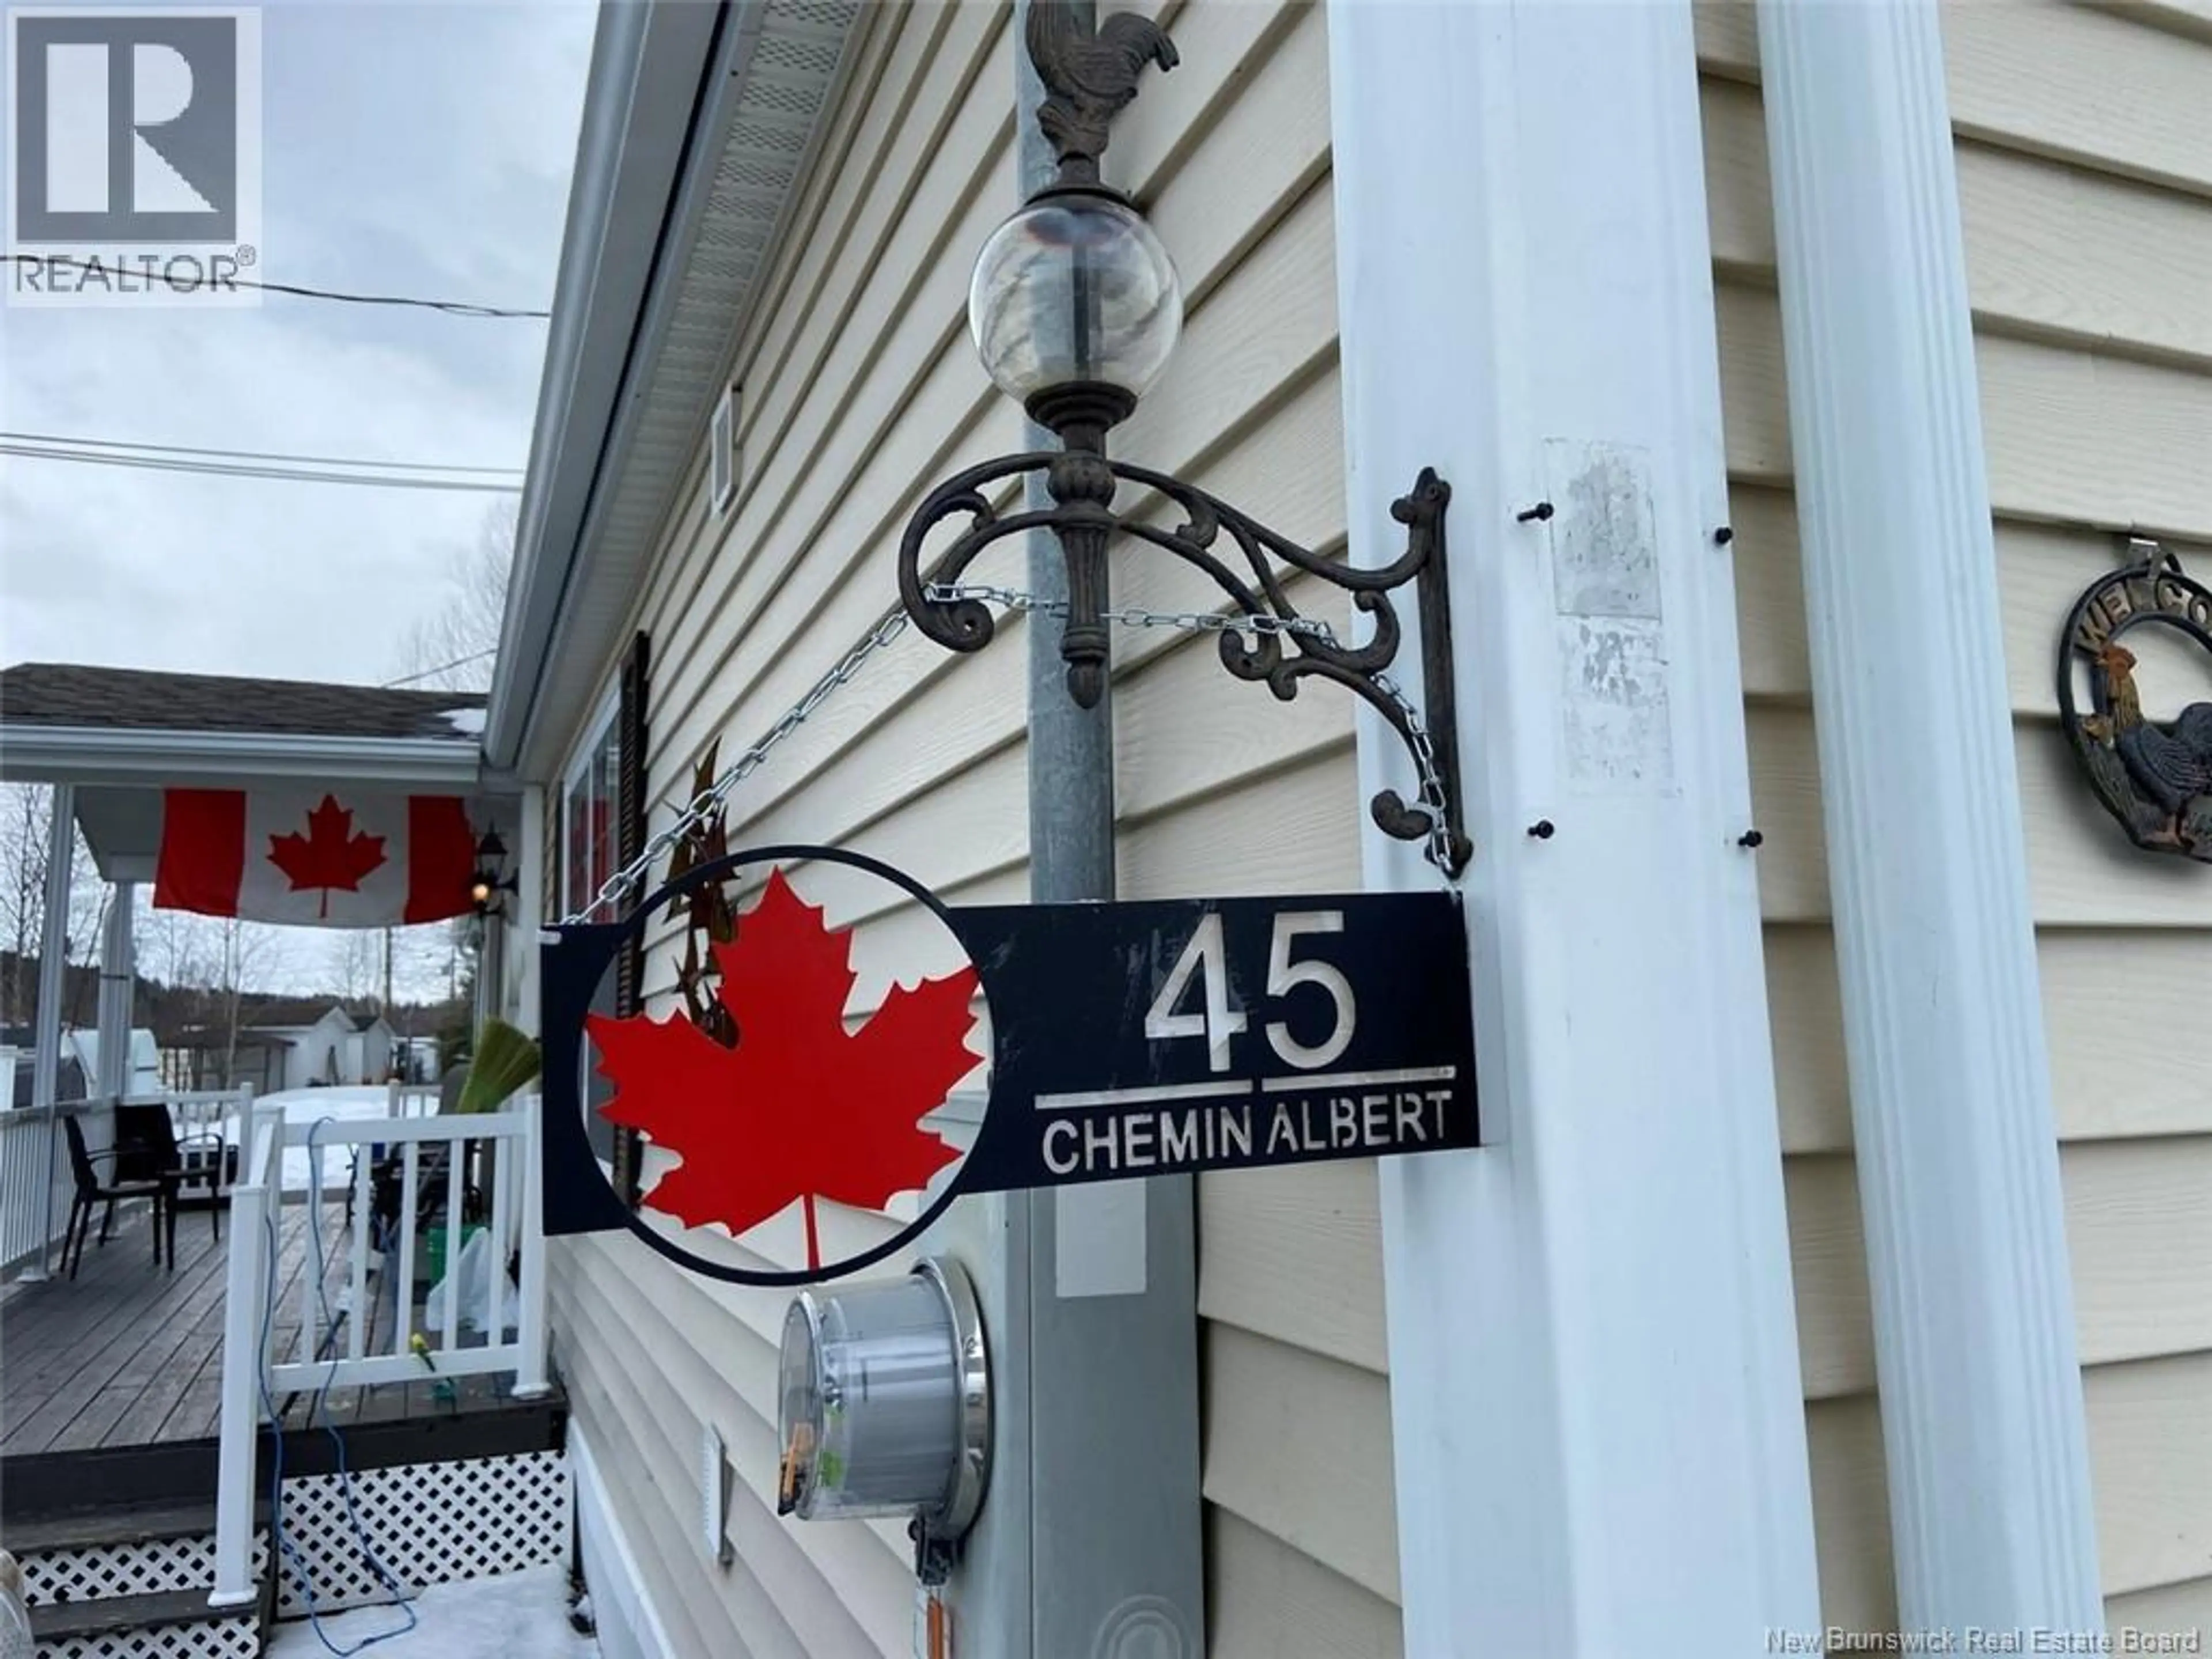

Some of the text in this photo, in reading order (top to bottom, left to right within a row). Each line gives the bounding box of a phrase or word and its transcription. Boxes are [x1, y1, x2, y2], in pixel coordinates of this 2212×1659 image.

[1145, 911, 1356, 1071] 45
[1042, 1090, 1453, 1174] CHEMIN ALBERT
